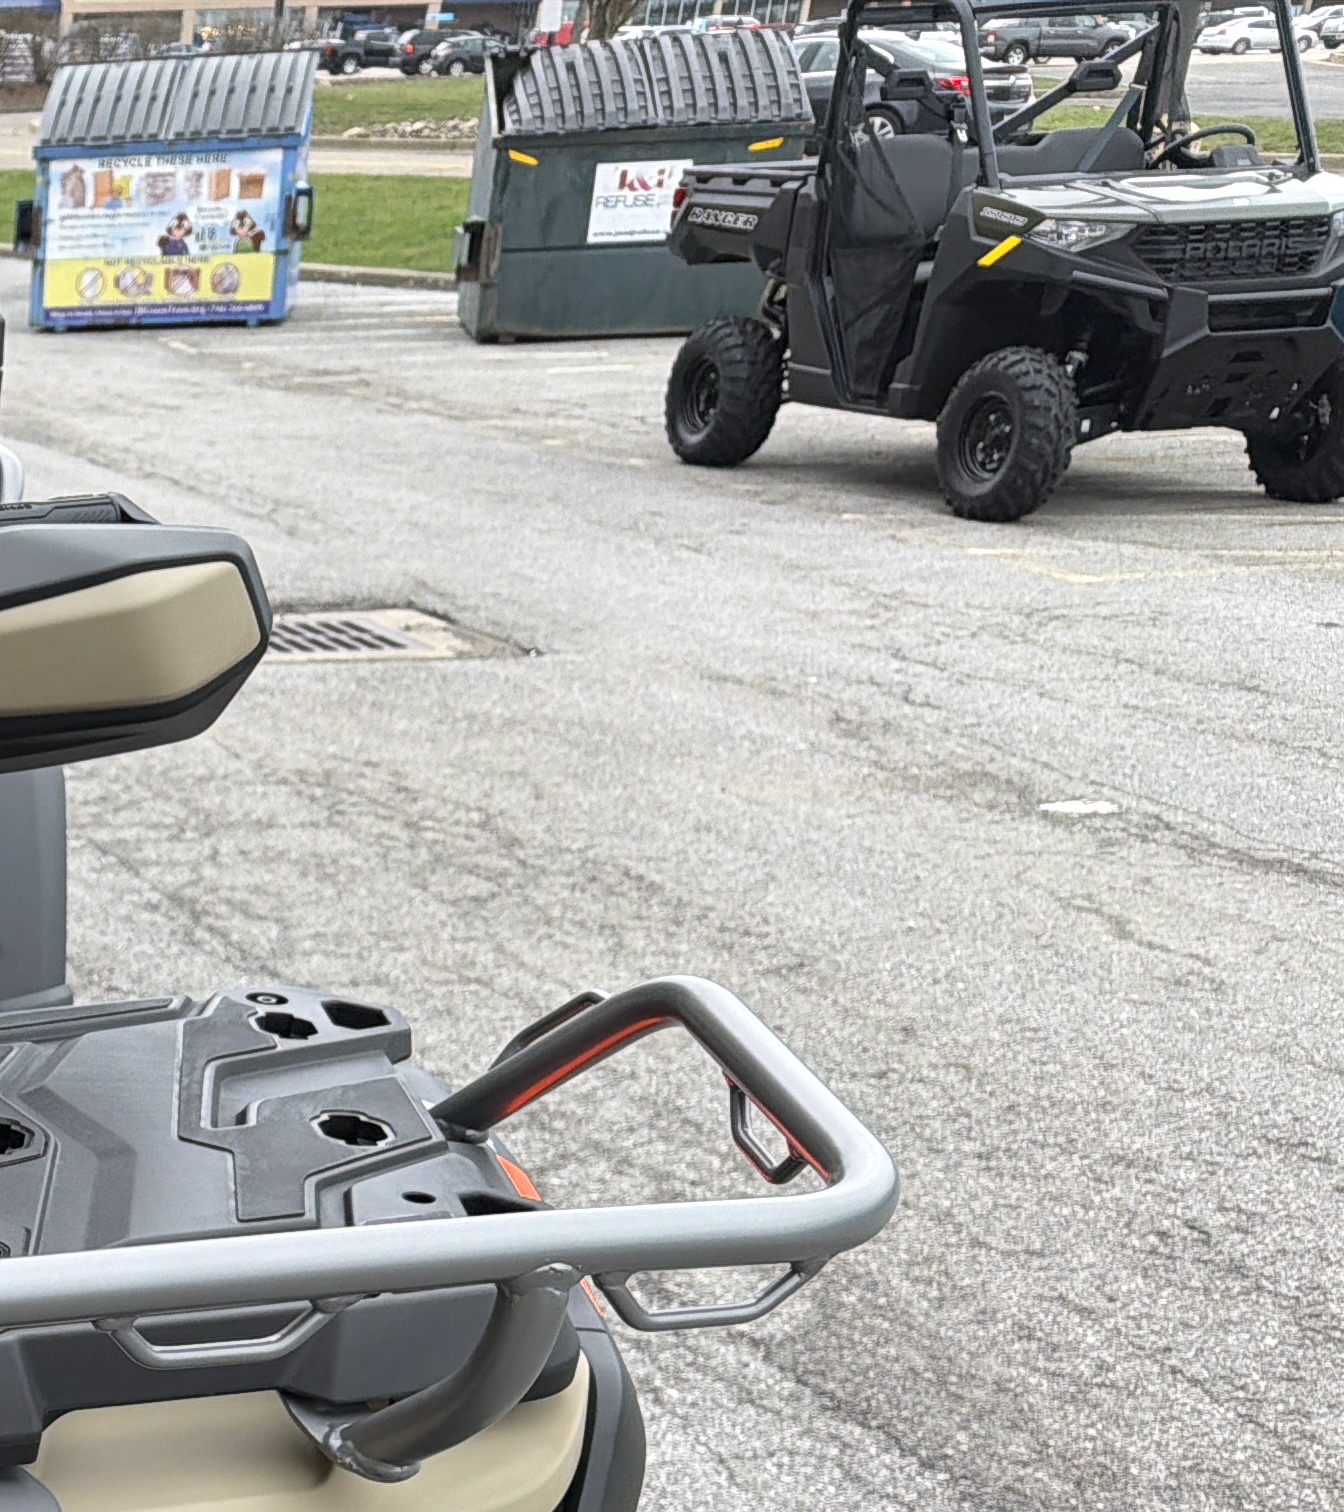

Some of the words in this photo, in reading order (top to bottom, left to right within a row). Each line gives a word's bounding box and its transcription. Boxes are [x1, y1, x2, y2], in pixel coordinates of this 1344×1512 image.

[97, 155, 151, 168] RECYCLE
[156, 153, 193, 166] THESE
[688, 206, 759, 232] RANGER
[1185, 237, 1306, 262] POLARIS
